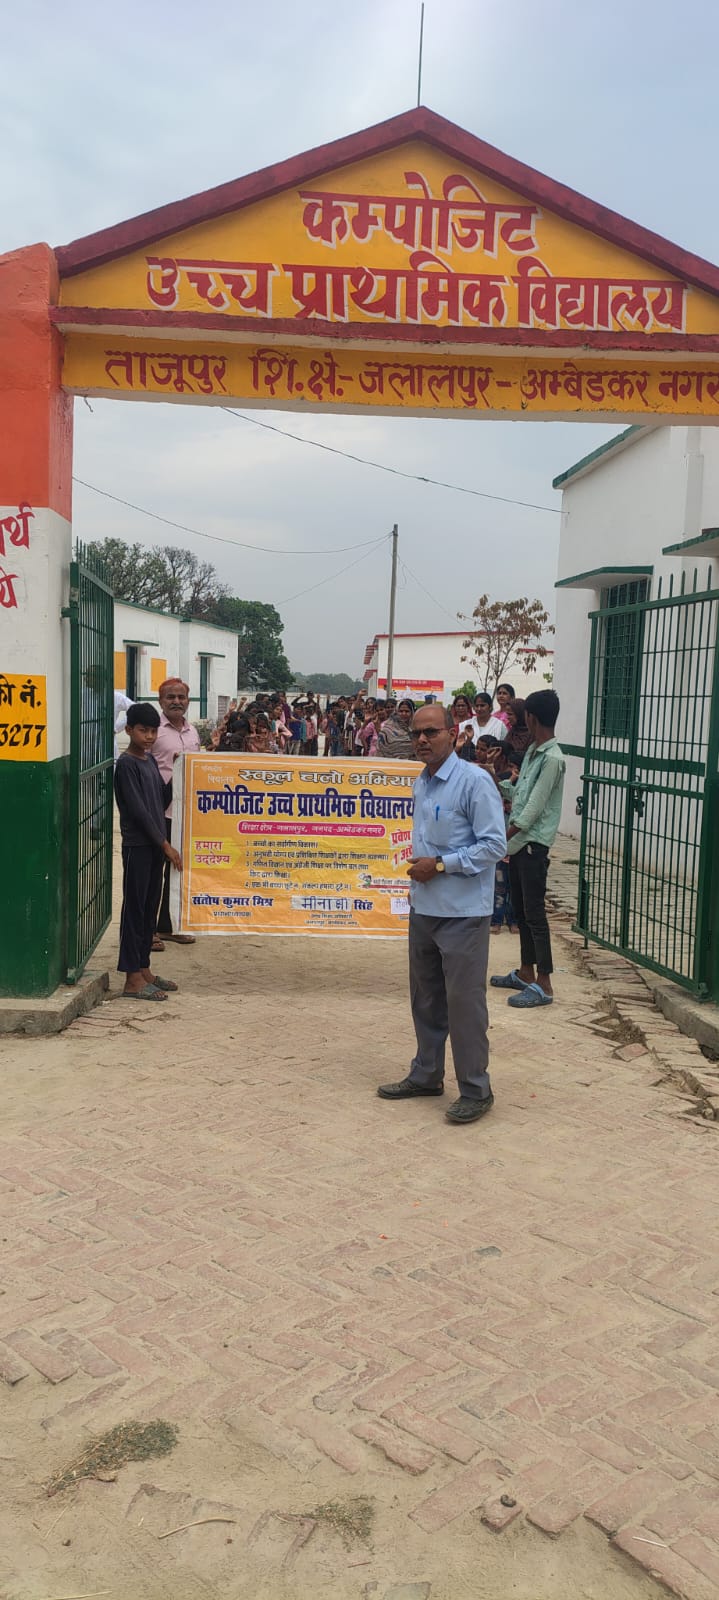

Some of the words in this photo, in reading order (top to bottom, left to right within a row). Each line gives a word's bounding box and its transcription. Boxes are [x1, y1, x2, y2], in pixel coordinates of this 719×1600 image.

[298, 171, 541, 258] कम्पोजिट
[145, 256, 278, 318] उच्च
[281, 250, 509, 325] प्राथमिक
[510, 255, 689, 333] विद्यालय
[104, 350, 227, 394] ताजूपुर
[238, 769, 293, 785] स्कूल
[299, 771, 343, 784] चलो
[348, 770, 416, 787] अभिया
[197, 785, 264, 815] कम्पोजिट
[268, 793, 293, 816] उच्च
[297, 788, 357, 818] प्राथमिक
[195, 840, 223, 851] हमारा
[223, 896, 249, 909] कुमार
[252, 896, 273, 907] मिश्र
[354, 898, 373, 911] सिंह
